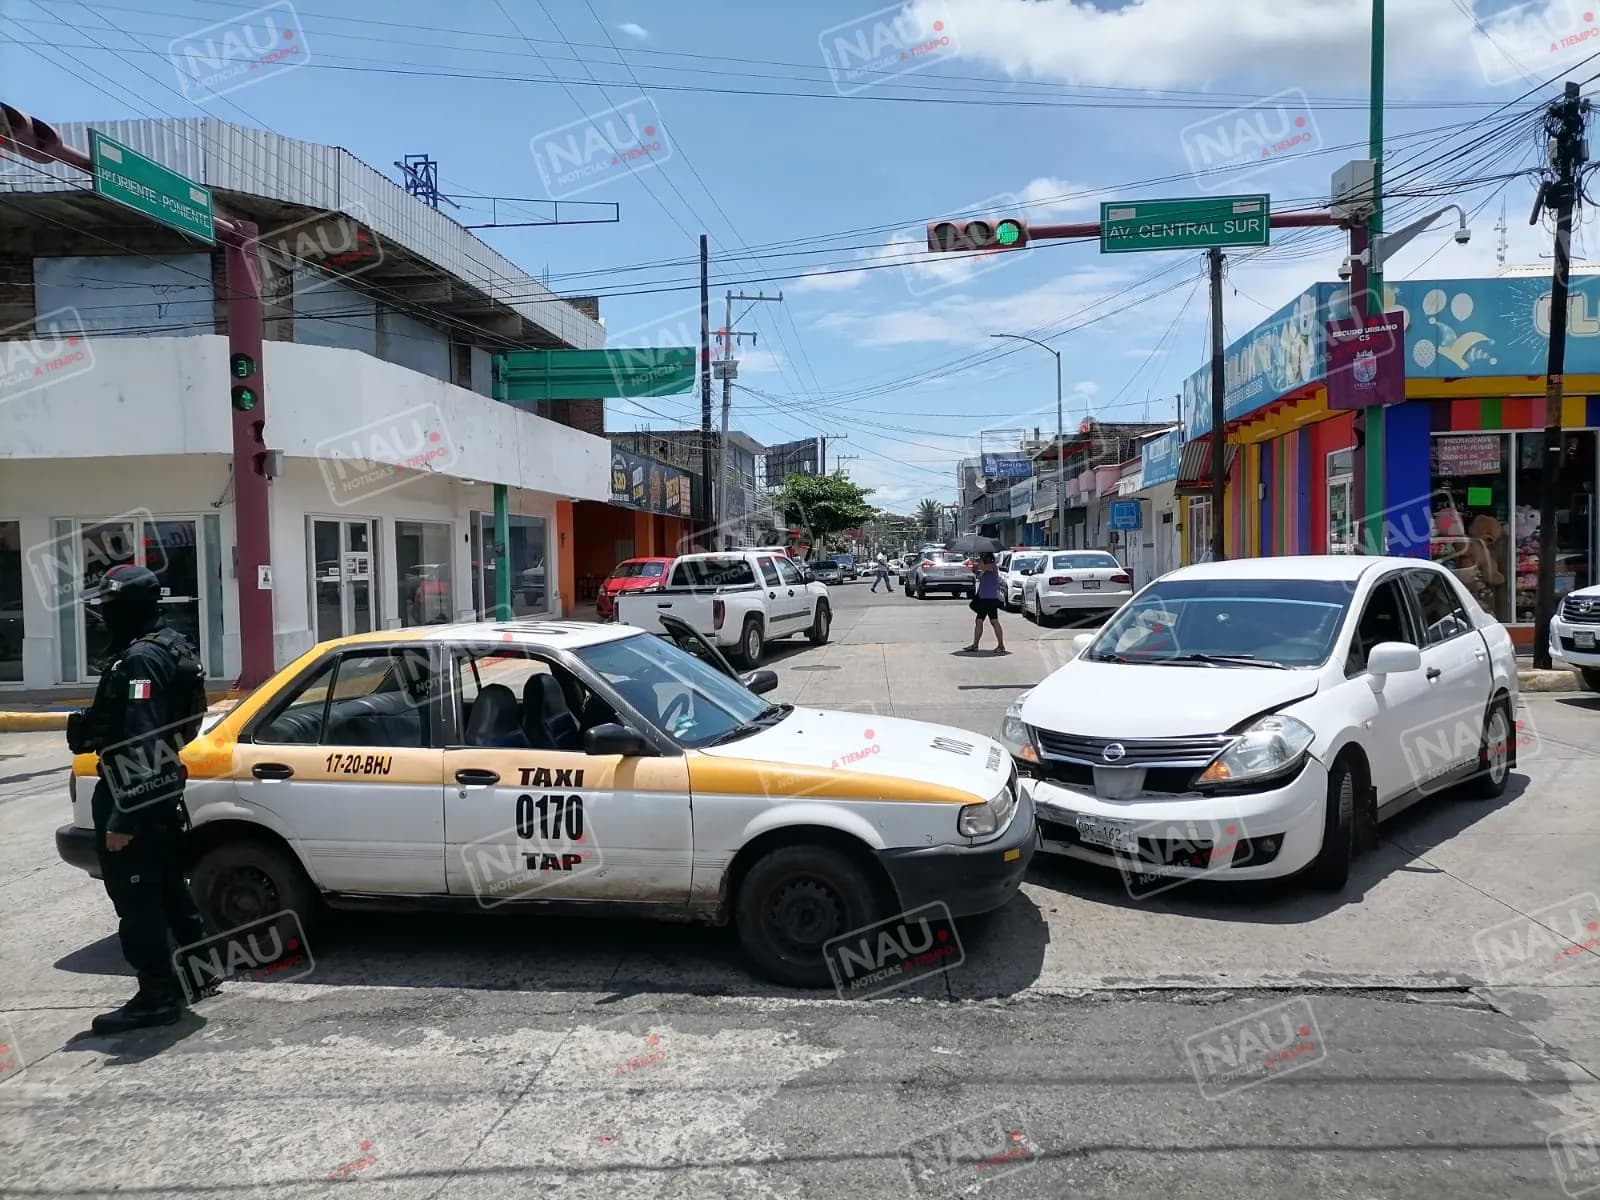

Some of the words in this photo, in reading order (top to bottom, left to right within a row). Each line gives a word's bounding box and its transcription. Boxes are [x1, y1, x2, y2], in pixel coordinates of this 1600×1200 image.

[112, 173, 156, 204] ORIENTE
[1110, 225, 1133, 239] AV.
[1138, 221, 1219, 239] CENTRAL
[1223, 218, 1260, 234] SUR
[1332, 328, 1363, 338] ESCUDO
[1364, 323, 1398, 334] URBANO
[326, 753, 393, 775] 17-20-BHJ
[518, 767, 584, 787] TAXI
[516, 794, 584, 840] 0170
[521, 852, 581, 871] TAP
